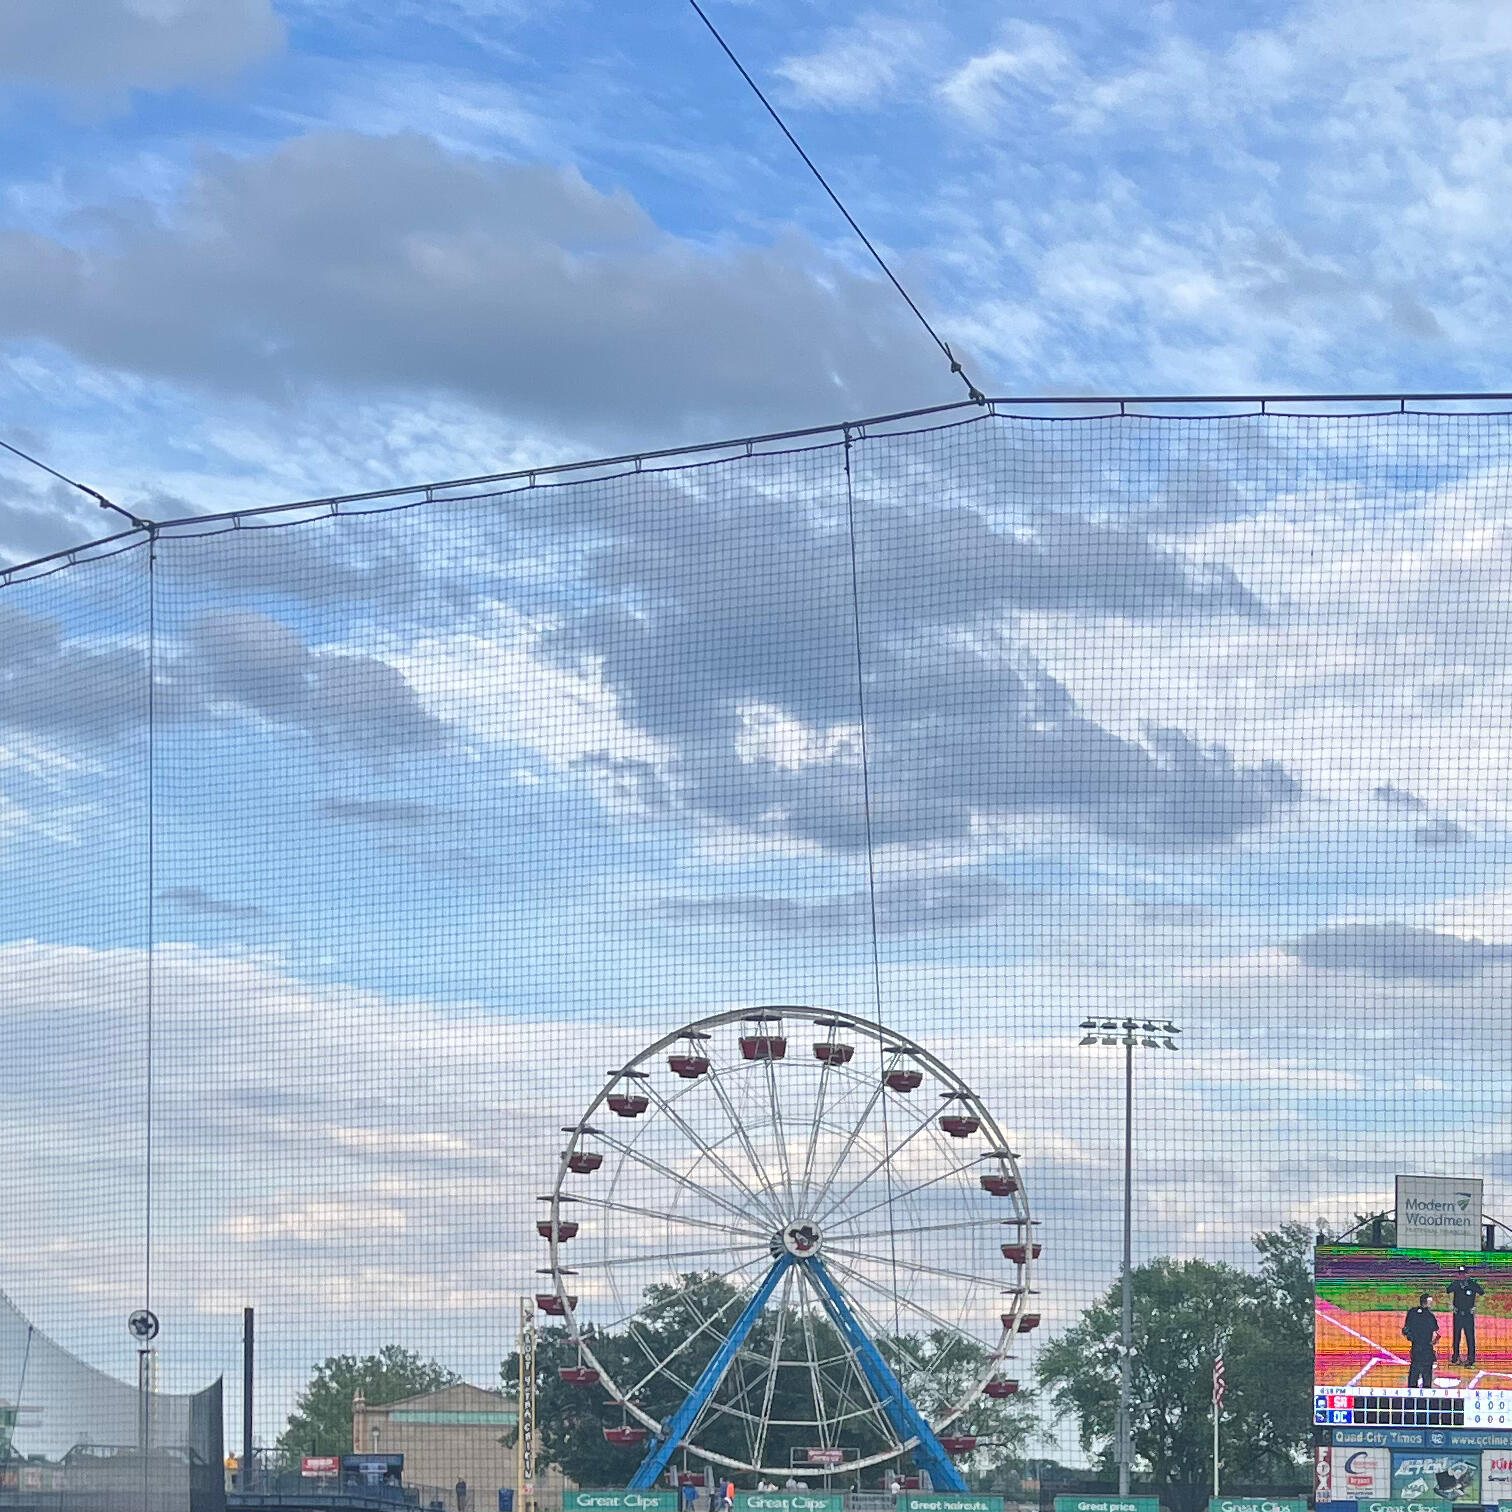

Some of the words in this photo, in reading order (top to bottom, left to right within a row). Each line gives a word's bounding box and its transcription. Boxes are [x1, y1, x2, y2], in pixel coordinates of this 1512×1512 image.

[1405, 1198, 1456, 1212] Modern
[1405, 1212, 1471, 1227] Woodmen
[1389, 1431, 1423, 1444] Times
[577, 1493, 620, 1508] Great
[624, 1494, 660, 1511] Clips
[747, 1496, 788, 1509] Great
[792, 1496, 826, 1512] Clips
[910, 1500, 942, 1511] Great
[943, 1501, 989, 1511] haircuts.
[1077, 1501, 1108, 1512] Great
